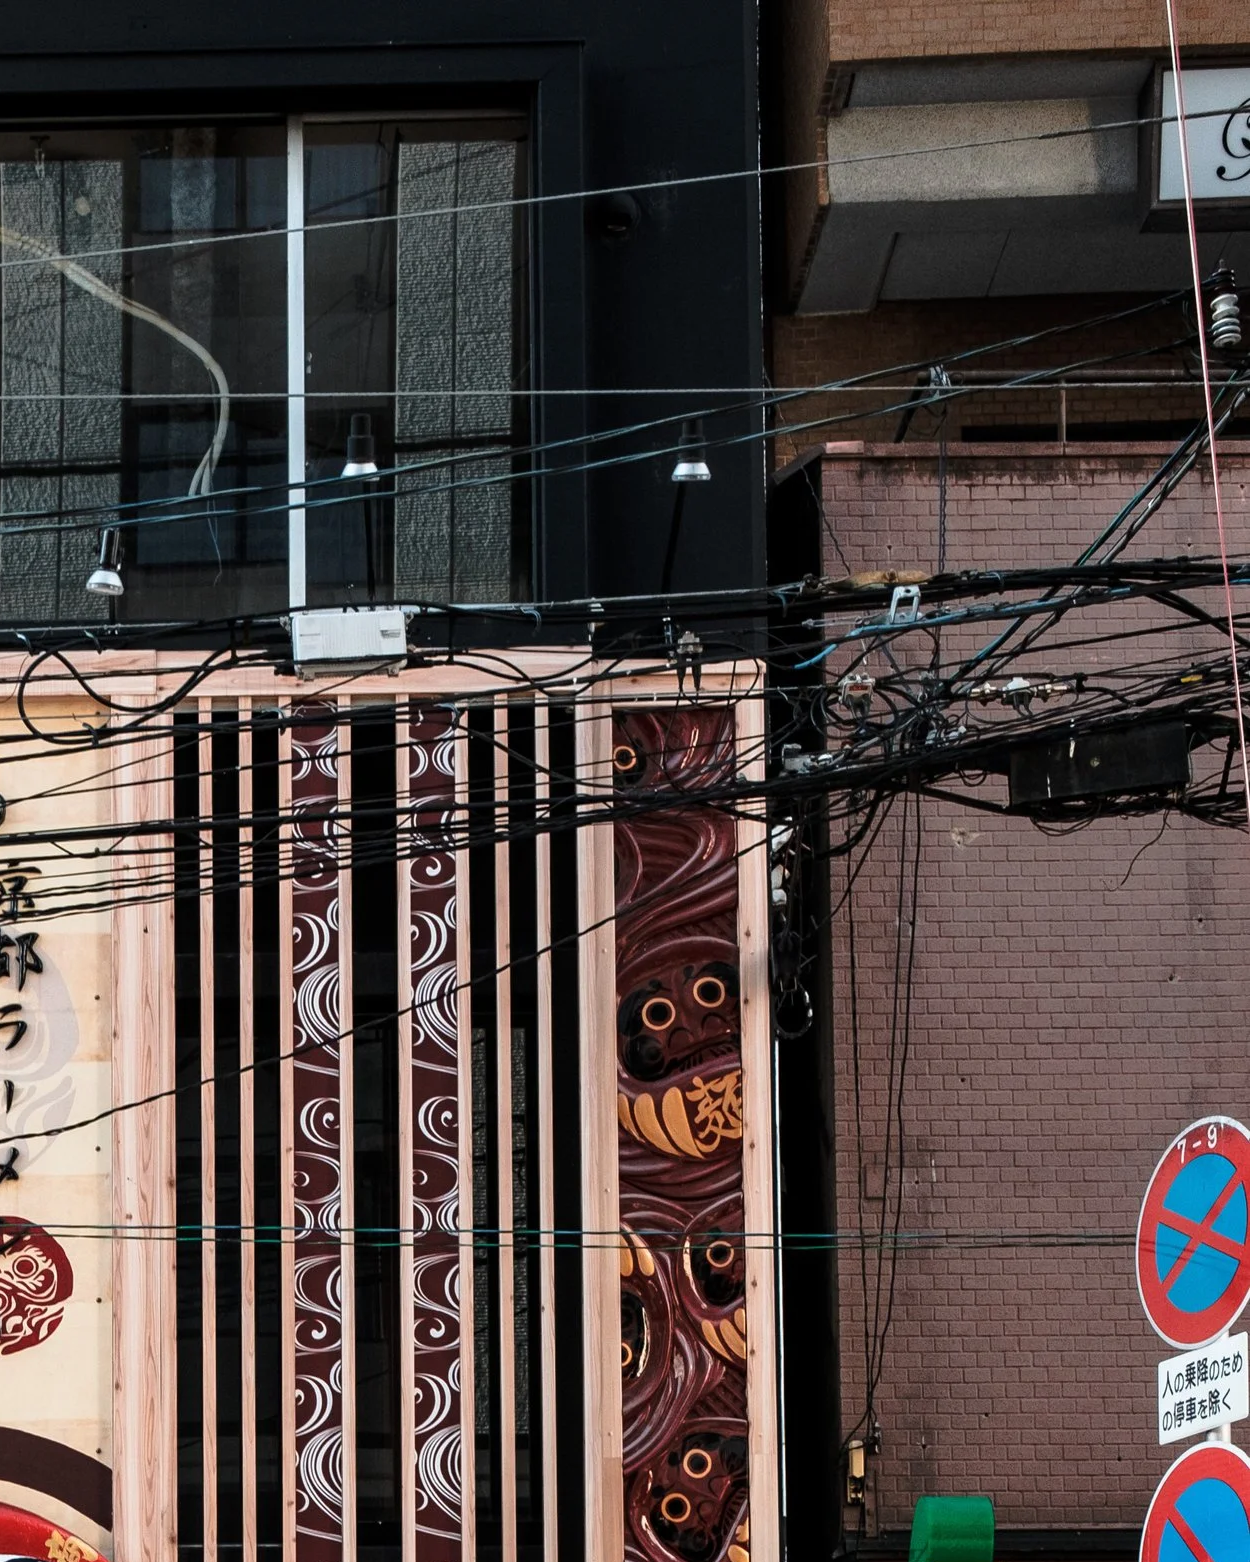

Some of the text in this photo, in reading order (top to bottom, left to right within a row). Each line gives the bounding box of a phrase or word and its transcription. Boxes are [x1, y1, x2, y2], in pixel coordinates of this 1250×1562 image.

[1176, 1123, 1218, 1165] 7-9
[1162, 1350, 1243, 1399] 人の乗降のため
[1162, 1388, 1232, 1432] の停車を除く
